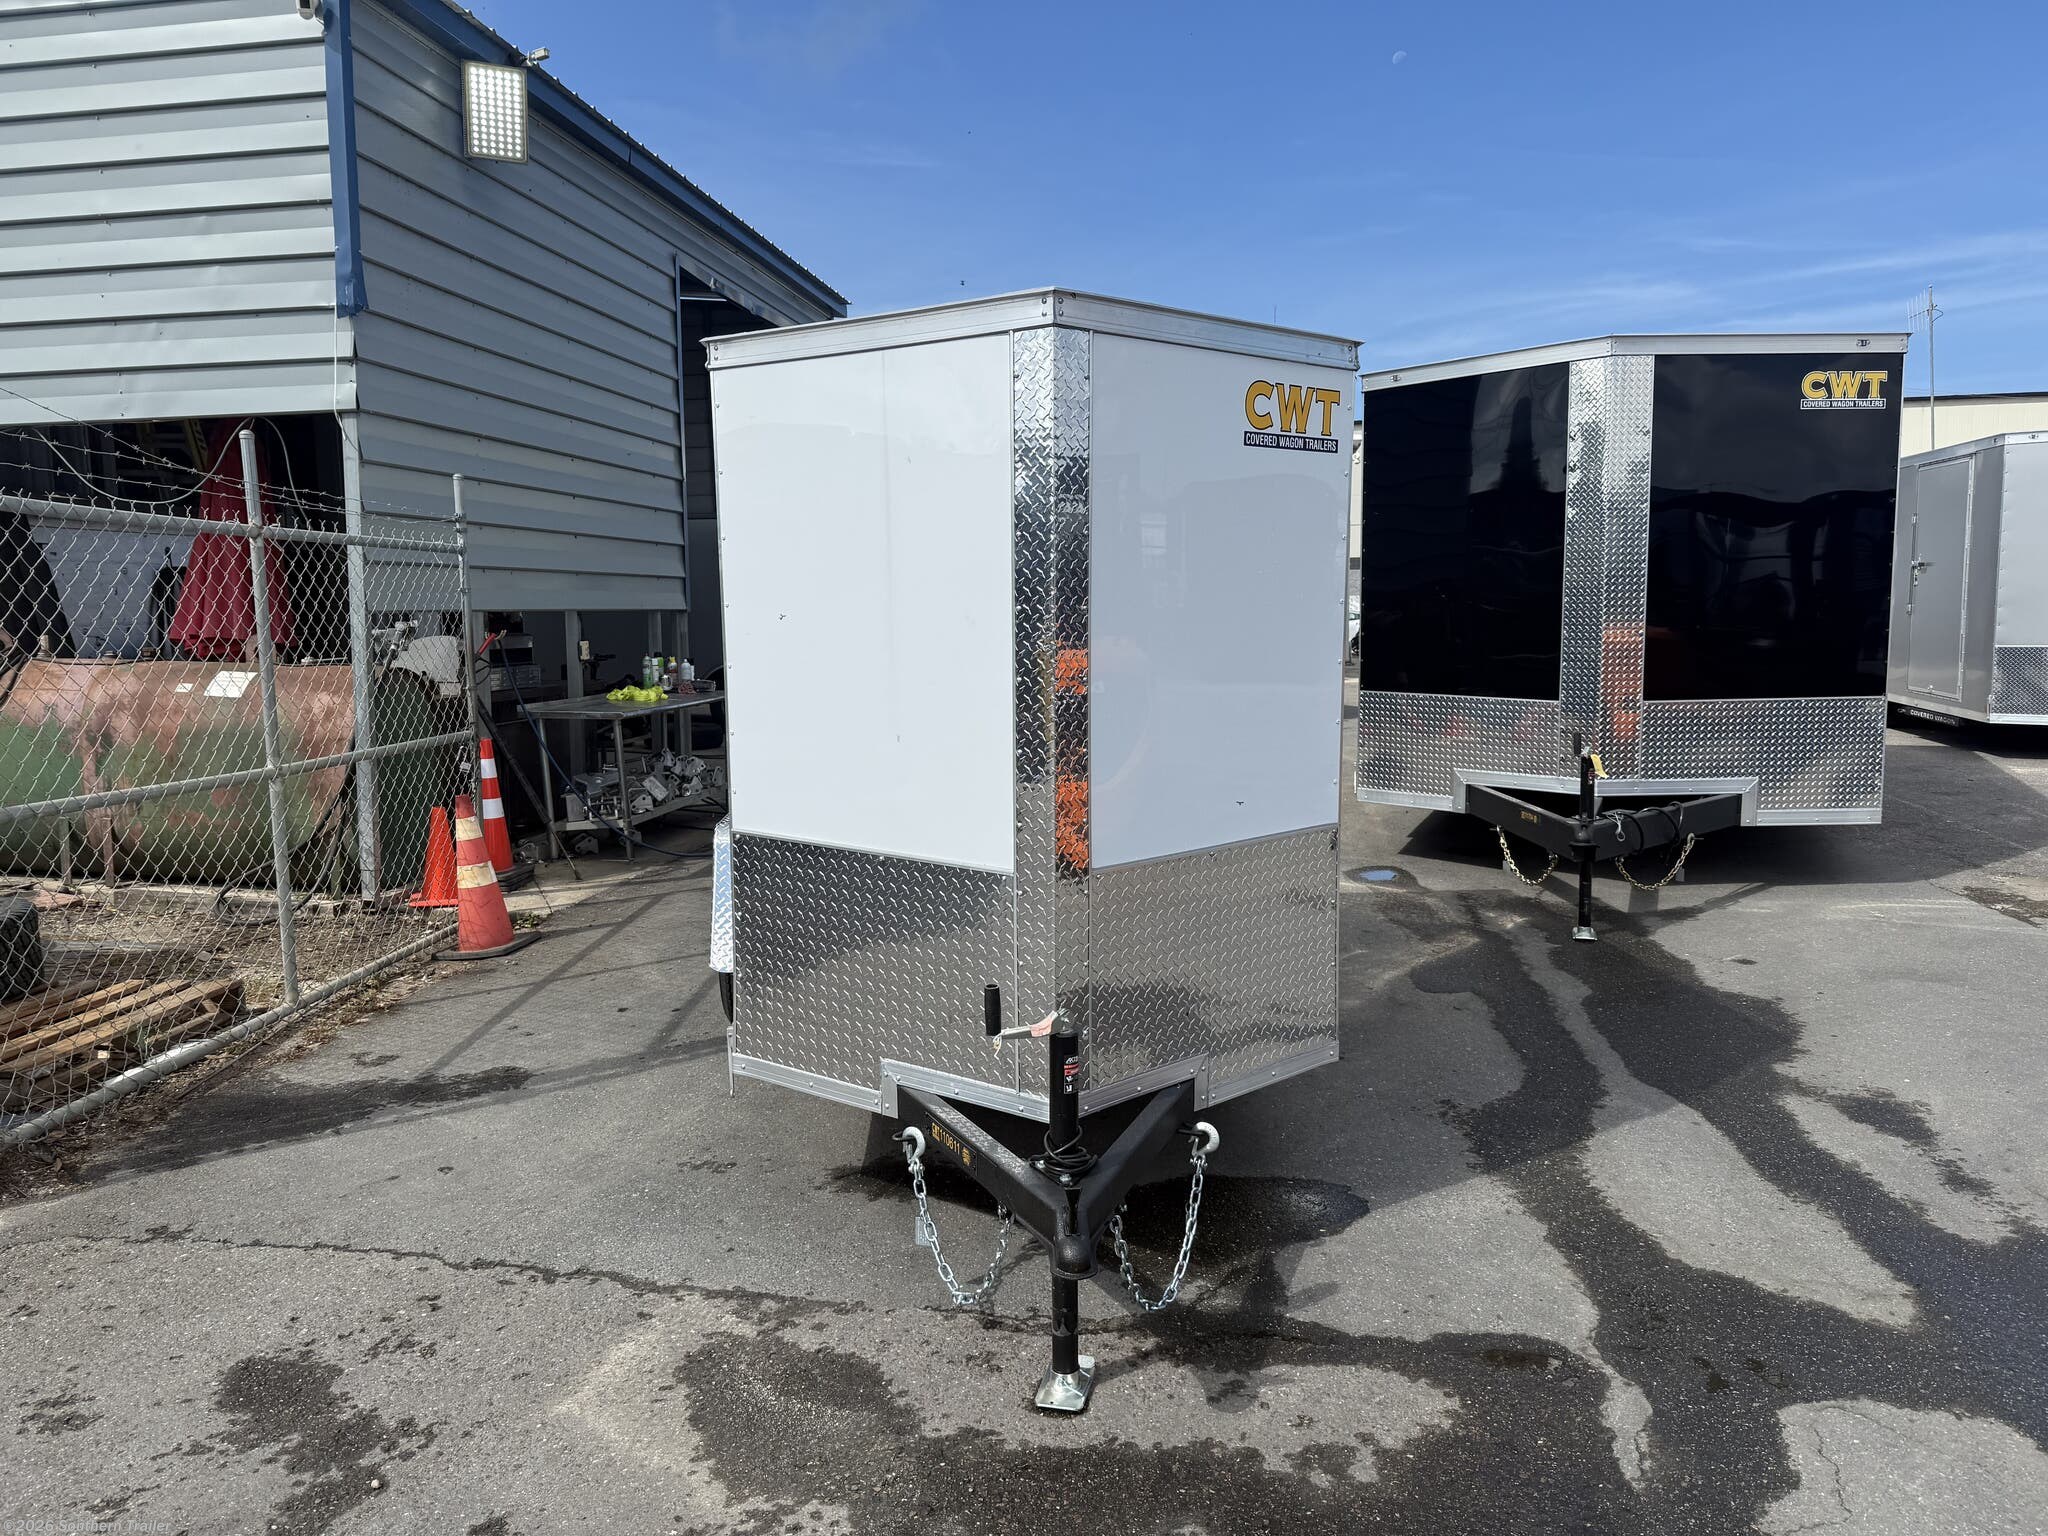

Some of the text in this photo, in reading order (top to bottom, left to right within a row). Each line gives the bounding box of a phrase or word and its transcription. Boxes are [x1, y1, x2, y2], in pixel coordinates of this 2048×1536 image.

[1801, 371, 1887, 399] CWT
[1245, 380, 1340, 436] CWT
[1803, 400, 1883, 408] COVERED WAGON TRAILERS
[1246, 433, 1337, 451] COVERED WAGON TRAILERS
[1910, 709, 1934, 720] COVERED
